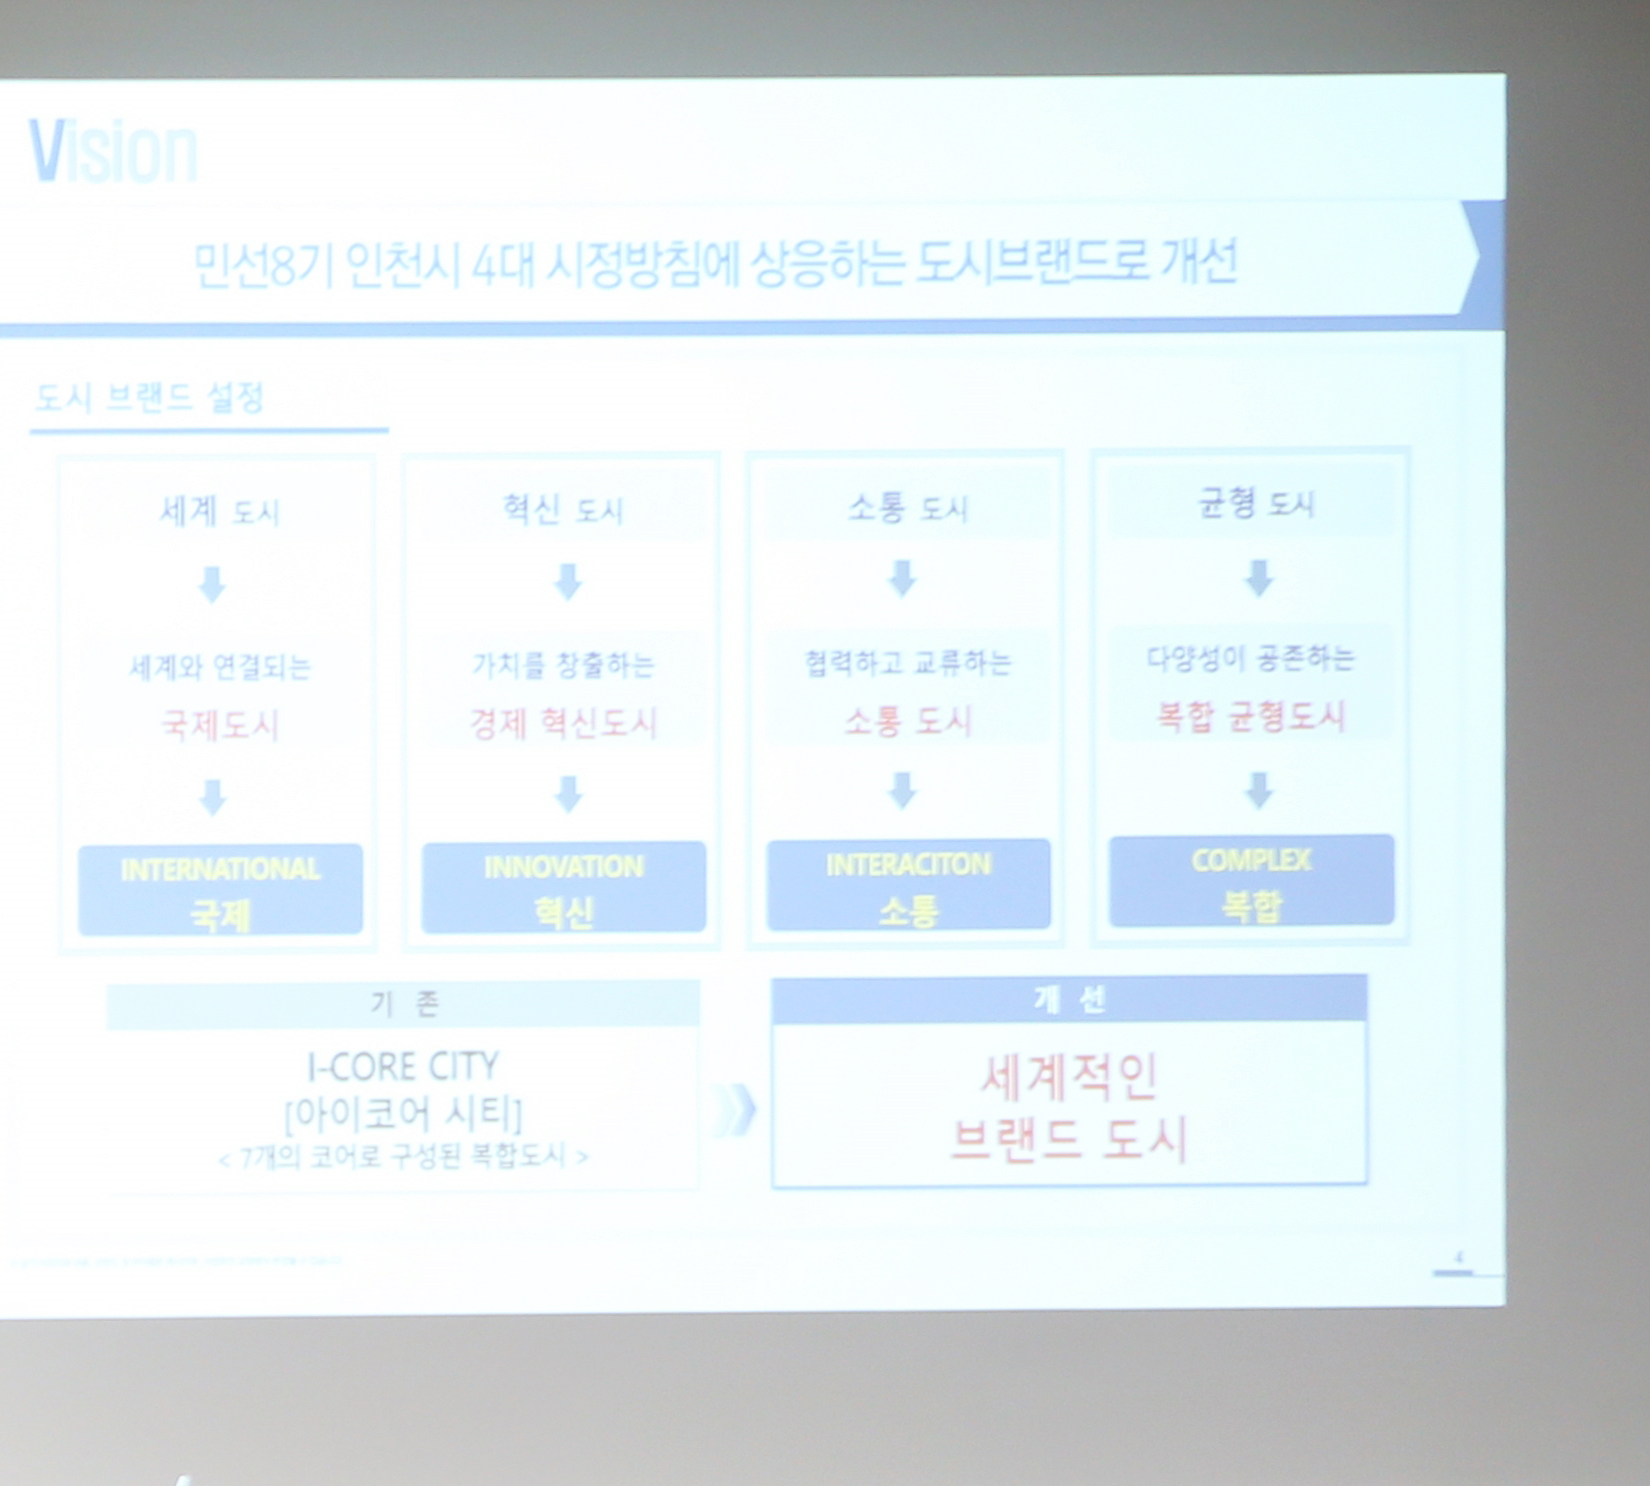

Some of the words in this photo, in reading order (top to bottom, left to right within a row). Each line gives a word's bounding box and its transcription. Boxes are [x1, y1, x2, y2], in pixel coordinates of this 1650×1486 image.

[27, 117, 200, 184] Vision
[195, 242, 334, 291] 민선8기
[346, 241, 460, 290] 인천시
[471, 241, 535, 289] 4대
[547, 240, 740, 291] 시정방침에
[750, 239, 908, 290] 상응하는
[916, 238, 1151, 287] 도시브랜드로
[1161, 236, 1237, 285] 개선
[35, 381, 92, 415] 도시
[107, 381, 194, 415] 브랜드
[207, 381, 264, 416] 설정
[160, 494, 217, 528] 세계
[232, 499, 279, 528] 도시
[503, 493, 560, 527] 혁신
[576, 497, 623, 526] 도시
[849, 490, 906, 525] 소통
[920, 495, 968, 524] 도시
[1199, 486, 1255, 520] 균형
[1268, 491, 1314, 519] 도시
[129, 653, 204, 682] 세계와
[213, 653, 311, 682] 연결되는
[473, 651, 546, 681] 가치를
[557, 651, 654, 680] 창출하는
[805, 649, 904, 679] 협력하고
[914, 649, 1012, 677] 교류하는
[1147, 644, 1245, 674] 다양성이
[1257, 644, 1356, 673] 공존하는
[163, 709, 278, 742] 국제도시
[471, 707, 527, 741] 경제
[542, 707, 656, 740] 혁신도시
[846, 705, 902, 739] 소통
[916, 705, 971, 737] 도시
[1158, 700, 1216, 735] 복합
[1229, 700, 1345, 734] 균형도시
[120, 855, 323, 883] INTERNATIONAL
[483, 854, 646, 880] INNOVATION
[825, 851, 995, 878] INTERACITON
[1190, 847, 1315, 873] COMPLEX
[189, 897, 252, 935] 국제
[532, 895, 595, 932] 혁신
[877, 893, 942, 931] 소통
[1220, 888, 1285, 926] 복합
[308, 1050, 416, 1083] I-CORE
[428, 1049, 500, 1082] CITY
[982, 1052, 1156, 1102] 세계적인
[285, 1095, 430, 1139] [아이코어
[445, 1093, 523, 1137] 시티]
[311, 1144, 381, 1170] 코어로
[391, 1142, 461, 1171] 구성된
[471, 1141, 565, 1170] 복합도시
[951, 1116, 1083, 1165] 브랜드
[1103, 1115, 1186, 1164] 도시
